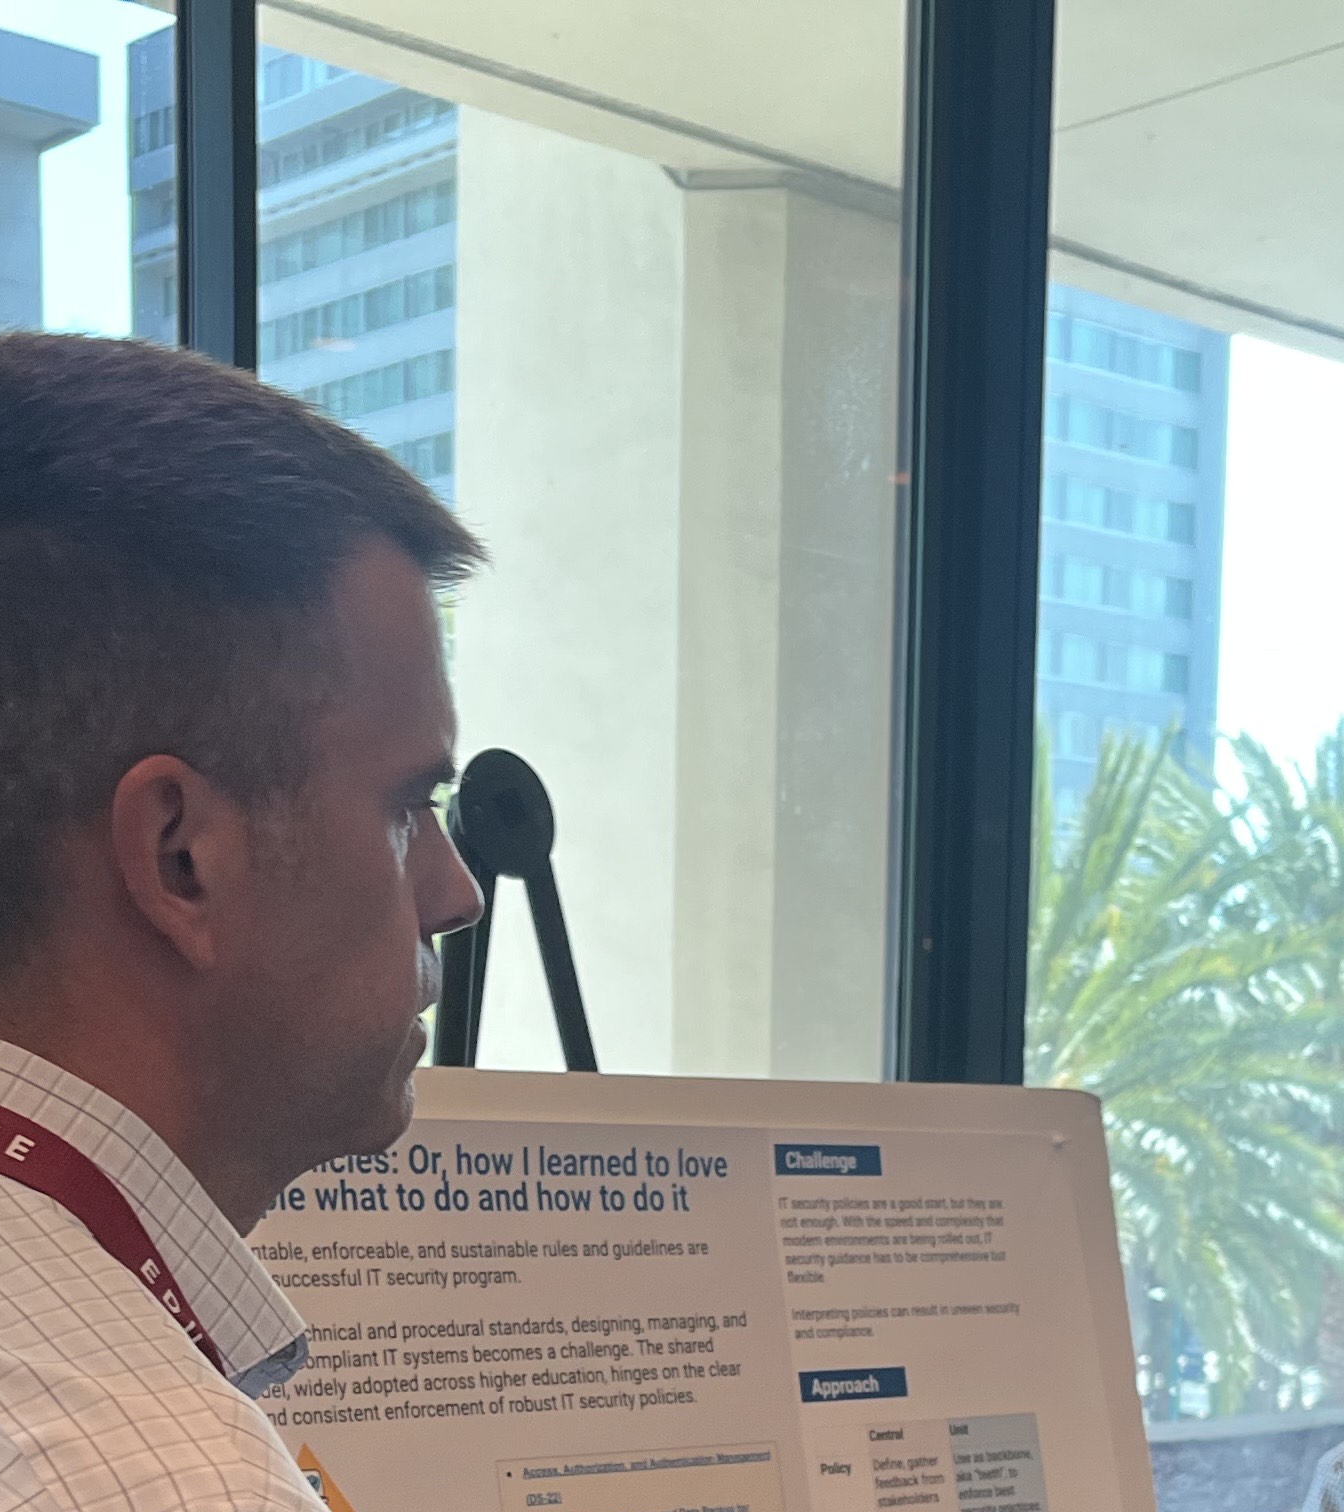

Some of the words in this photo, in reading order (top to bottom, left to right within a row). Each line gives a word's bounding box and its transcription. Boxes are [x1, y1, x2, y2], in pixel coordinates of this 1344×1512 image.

[313, 1151, 398, 1174] cies:
[409, 1144, 447, 1181] Or,
[456, 1144, 513, 1175] how
[523, 1146, 529, 1176] I
[539, 1145, 637, 1177] learned
[645, 1151, 670, 1177] to
[678, 1148, 728, 1178] love
[785, 1151, 857, 1174] Challenge
[315, 1179, 389, 1211] what
[396, 1183, 425, 1212] to
[434, 1180, 469, 1212] do
[478, 1181, 528, 1212] and
[536, 1181, 591, 1212] how
[599, 1185, 625, 1212] to
[633, 1183, 665, 1212] do
[671, 1183, 690, 1212] it
[312, 1240, 414, 1261] enforceable,
[418, 1240, 446, 1259] and
[451, 1240, 538, 1260] sustainable
[542, 1239, 579, 1258] rules
[583, 1240, 609, 1258] and
[612, 1238, 684, 1260] guidelines
[688, 1240, 709, 1256] are
[271, 1268, 362, 1288] successful
[366, 1268, 382, 1286] IT
[387, 1267, 448, 1290] security
[453, 1269, 522, 1290] program.
[367, 1320, 397, 1340] and
[402, 1318, 485, 1341] procedural
[489, 1315, 568, 1337] standards,
[571, 1315, 645, 1337] designing,
[648, 1313, 720, 1334] managing,
[723, 1311, 747, 1328] and
[383, 1348, 398, 1367] IT
[403, 1348, 468, 1370] systems
[472, 1345, 543, 1363] becomes
[547, 1346, 556, 1359] a
[560, 1340, 634, 1361] challenge.
[636, 1338, 664, 1356] The
[668, 1336, 715, 1355] shared
[294, 1378, 347, 1401] widely
[352, 1375, 419, 1398] adopted
[424, 1374, 476, 1392] across
[479, 1370, 528, 1393] higher
[532, 1368, 608, 1387] education,
[610, 1365, 659, 1385] hinges
[662, 1366, 681, 1380] on
[683, 1361, 705, 1379] the
[709, 1359, 741, 1378] clear
[811, 1374, 879, 1398] Approach
[292, 1404, 381, 1425] consistent
[385, 1399, 486, 1421] enforcement
[489, 1395, 505, 1414] of
[509, 1395, 557, 1414] robust
[561, 1392, 574, 1410] IT
[580, 1391, 635, 1411] security
[639, 1387, 697, 1409] policies.
[869, 1426, 904, 1441] Central
[820, 1461, 851, 1476] Policy
